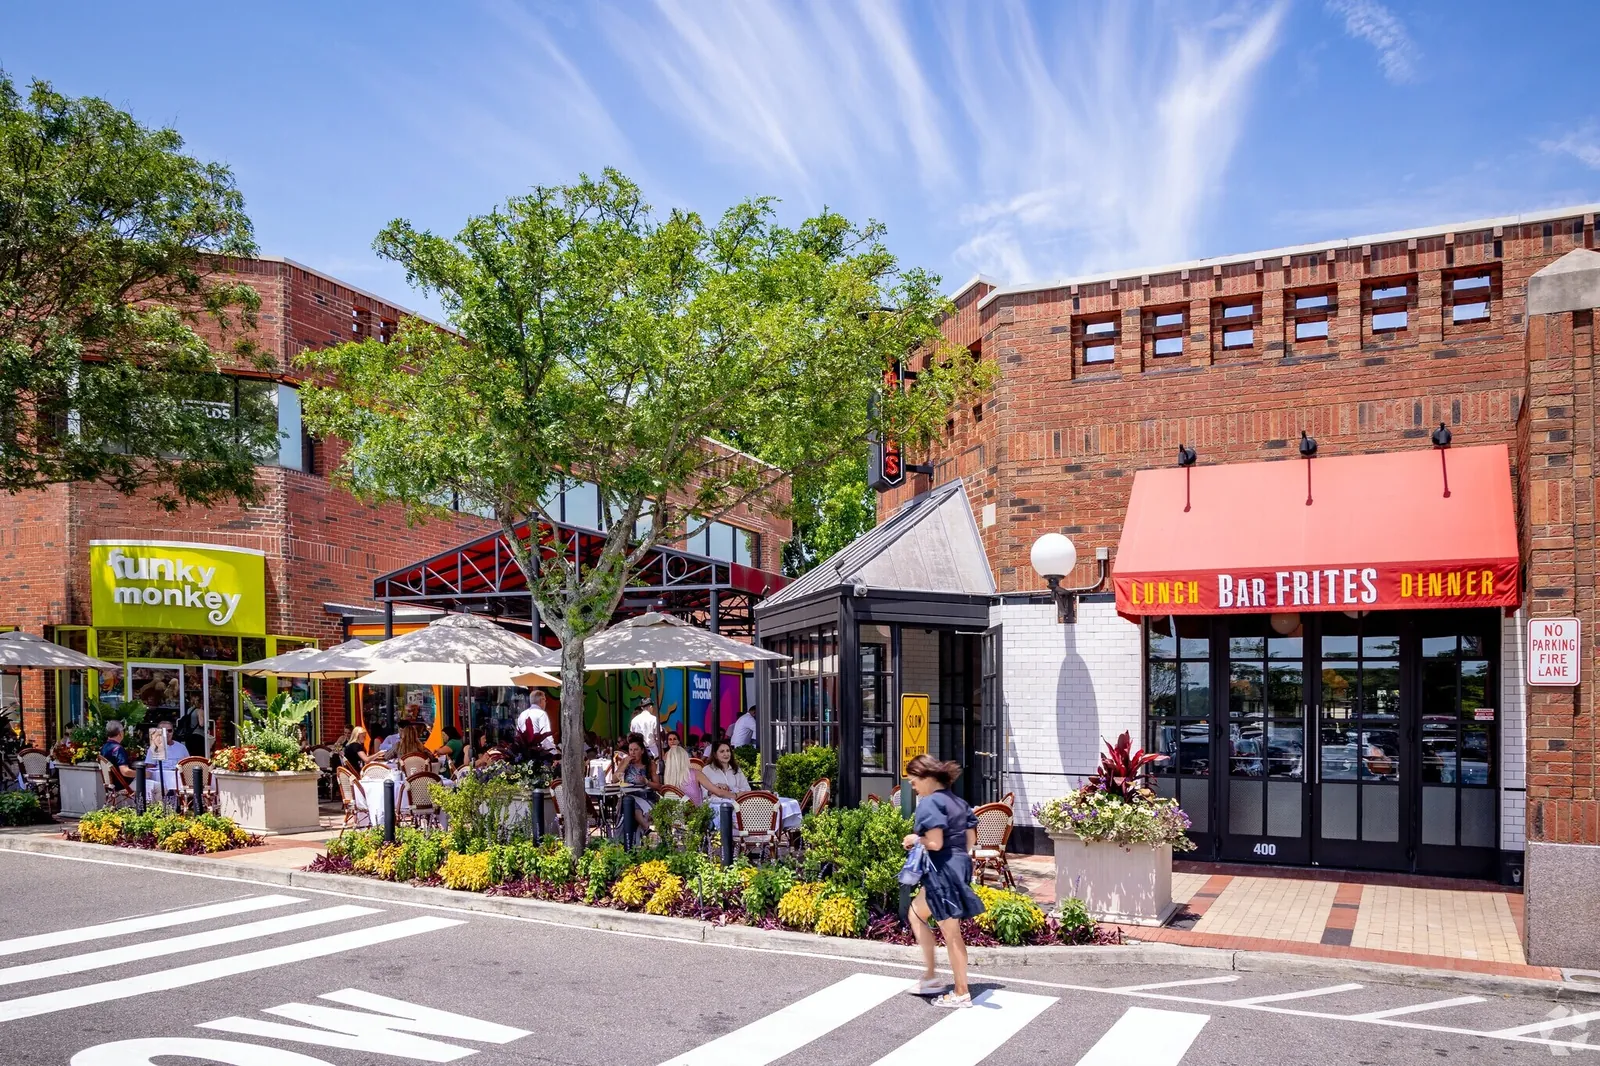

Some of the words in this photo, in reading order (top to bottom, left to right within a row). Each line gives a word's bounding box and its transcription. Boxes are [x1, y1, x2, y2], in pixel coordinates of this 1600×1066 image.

[107, 547, 216, 588] funky
[1131, 581, 1199, 605] LUNCH
[1217, 573, 1267, 608] BAR
[1275, 567, 1378, 606] FRITES
[1401, 570, 1494, 598] DINNER
[114, 584, 242, 626] monkey
[1544, 624, 1563, 637] NO
[1532, 639, 1576, 651] PARKING
[1540, 653, 1568, 664] FIRE
[1538, 666, 1569, 677] LANE
[908, 714, 922, 728] SLOW
[1253, 843, 1277, 856] 400
